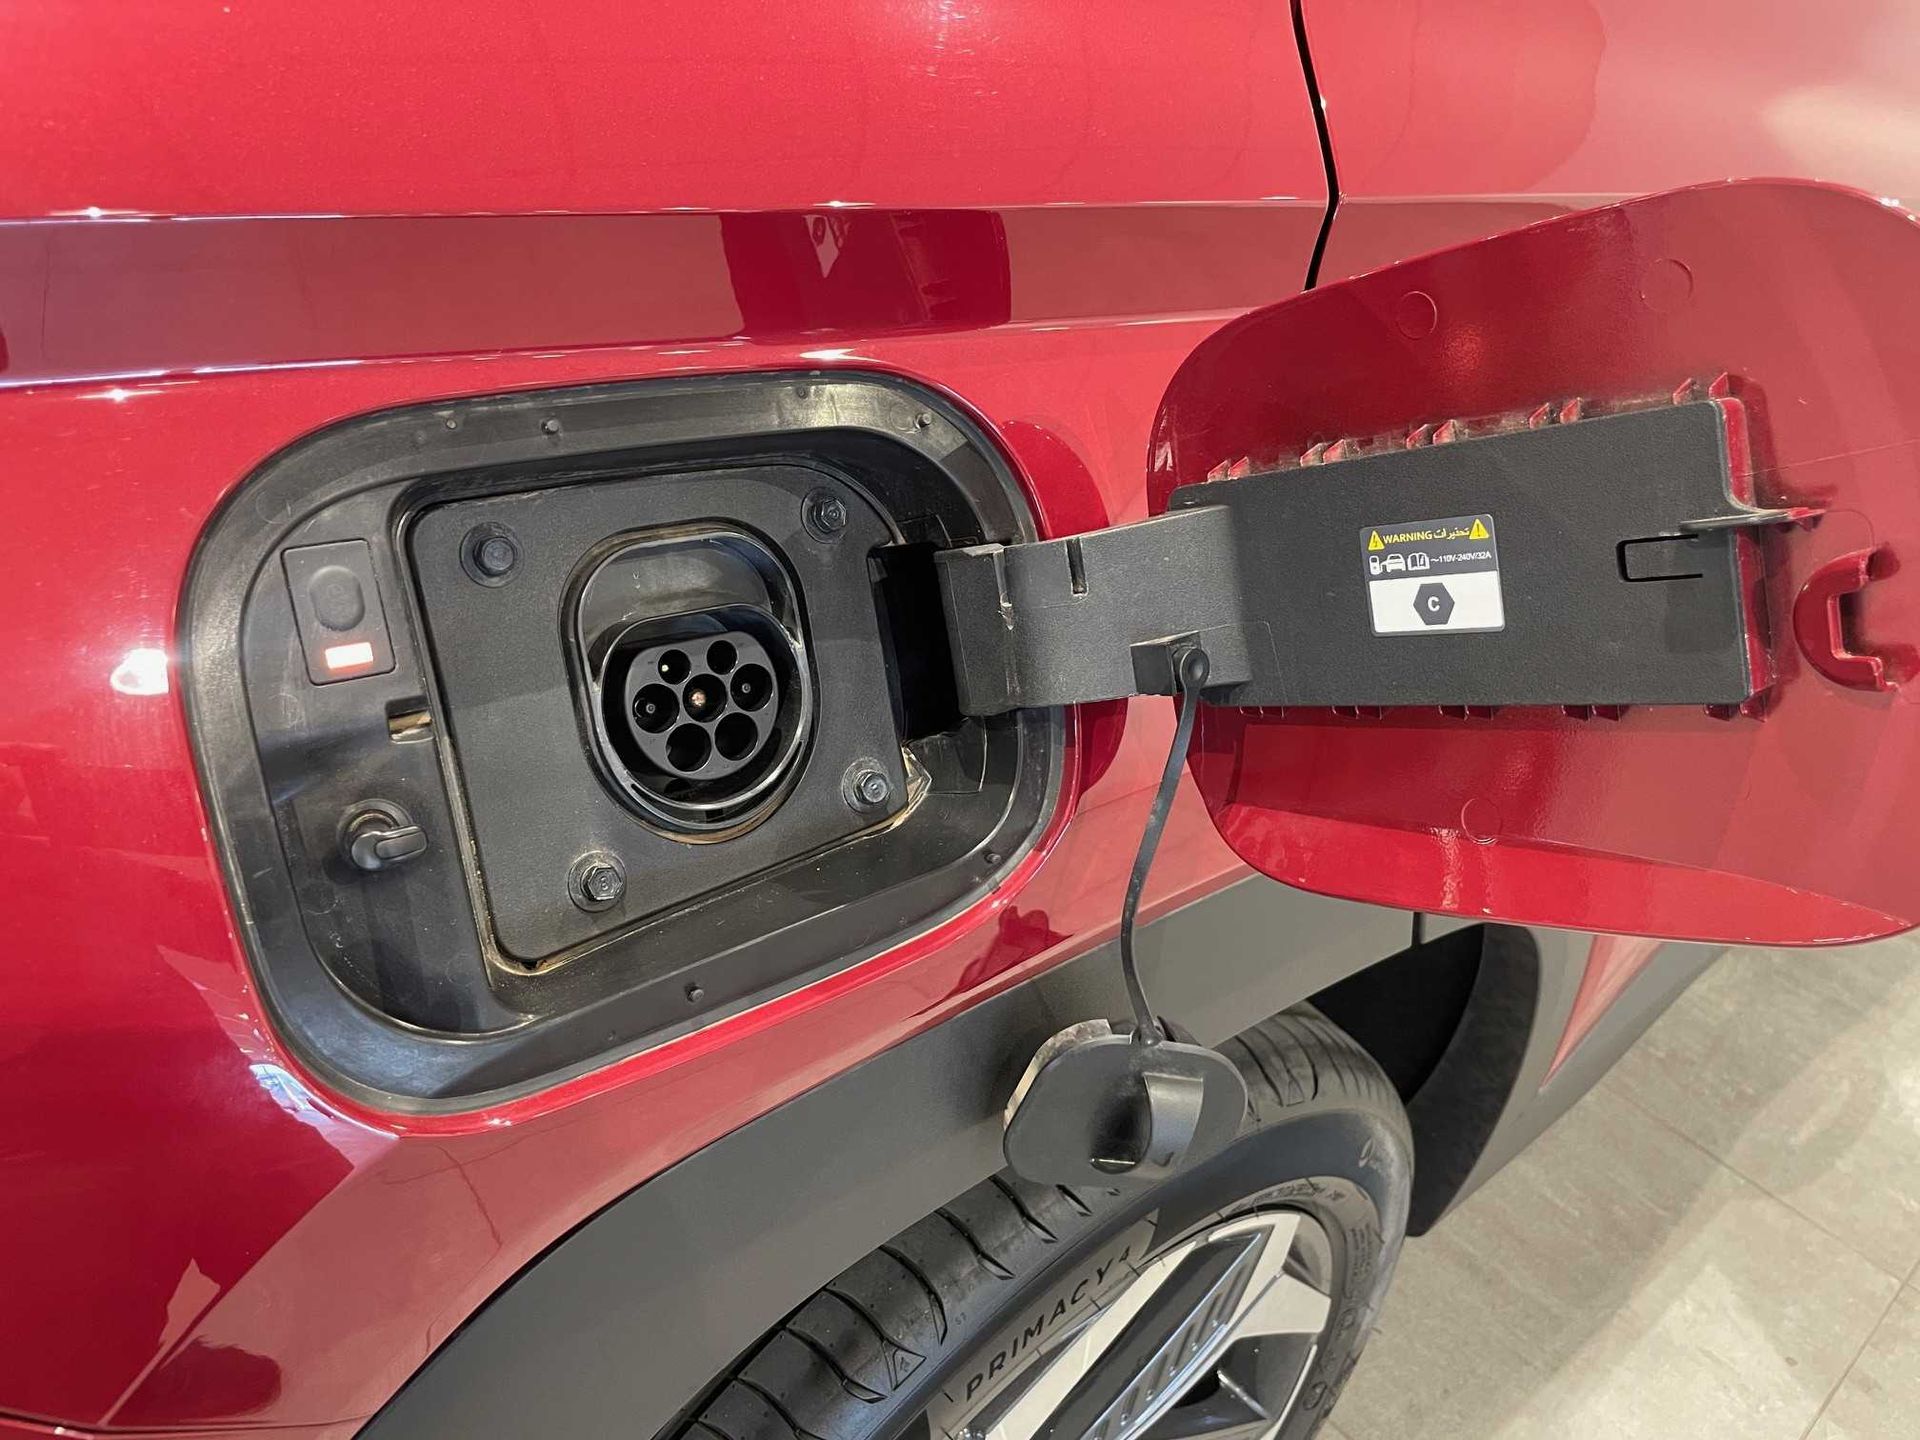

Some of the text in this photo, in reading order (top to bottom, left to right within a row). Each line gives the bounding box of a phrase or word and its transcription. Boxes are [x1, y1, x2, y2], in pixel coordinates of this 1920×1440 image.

[1382, 531, 1432, 544] WARNING
[1433, 527, 1470, 540] تحذيرات
[1427, 596, 1440, 611] C
[966, 1258, 1114, 1402] PRIMACY
